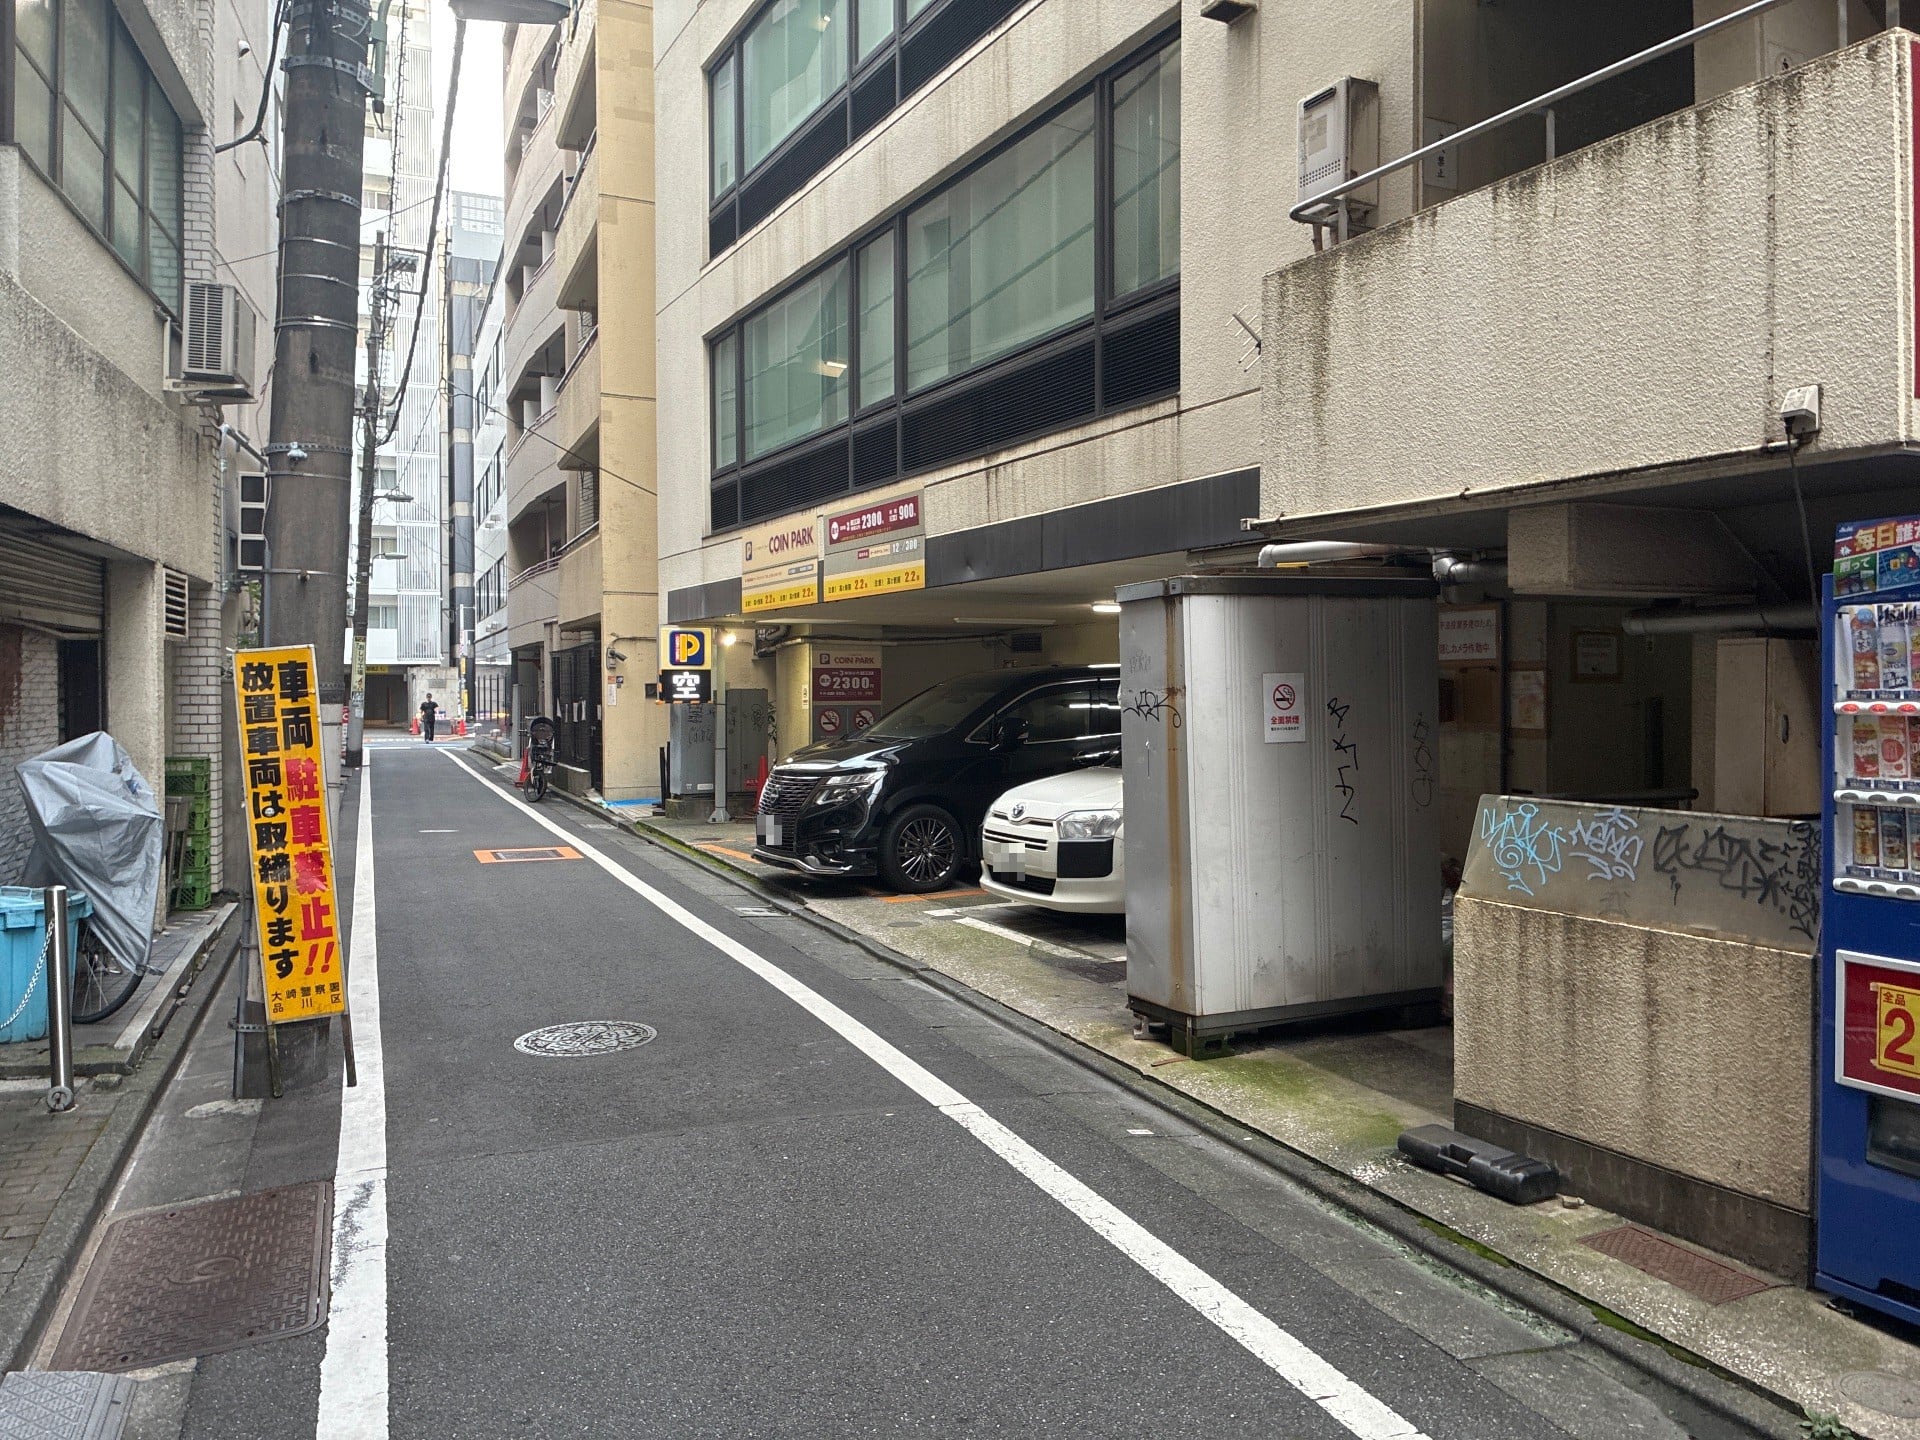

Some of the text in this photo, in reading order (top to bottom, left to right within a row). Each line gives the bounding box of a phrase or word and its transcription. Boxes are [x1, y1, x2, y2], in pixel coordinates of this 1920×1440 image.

[769, 533, 789, 555] COIN
[790, 526, 814, 549] PARK
[679, 633, 700, 663] P
[834, 656, 875, 664] COIN PARK
[672, 671, 700, 698] 空
[241, 662, 299, 980] 放置車両は取締ります
[271, 981, 341, 1003] 大崎警察署
[272, 993, 342, 1014] 品川区
[1883, 991, 1905, 1006] 全品
